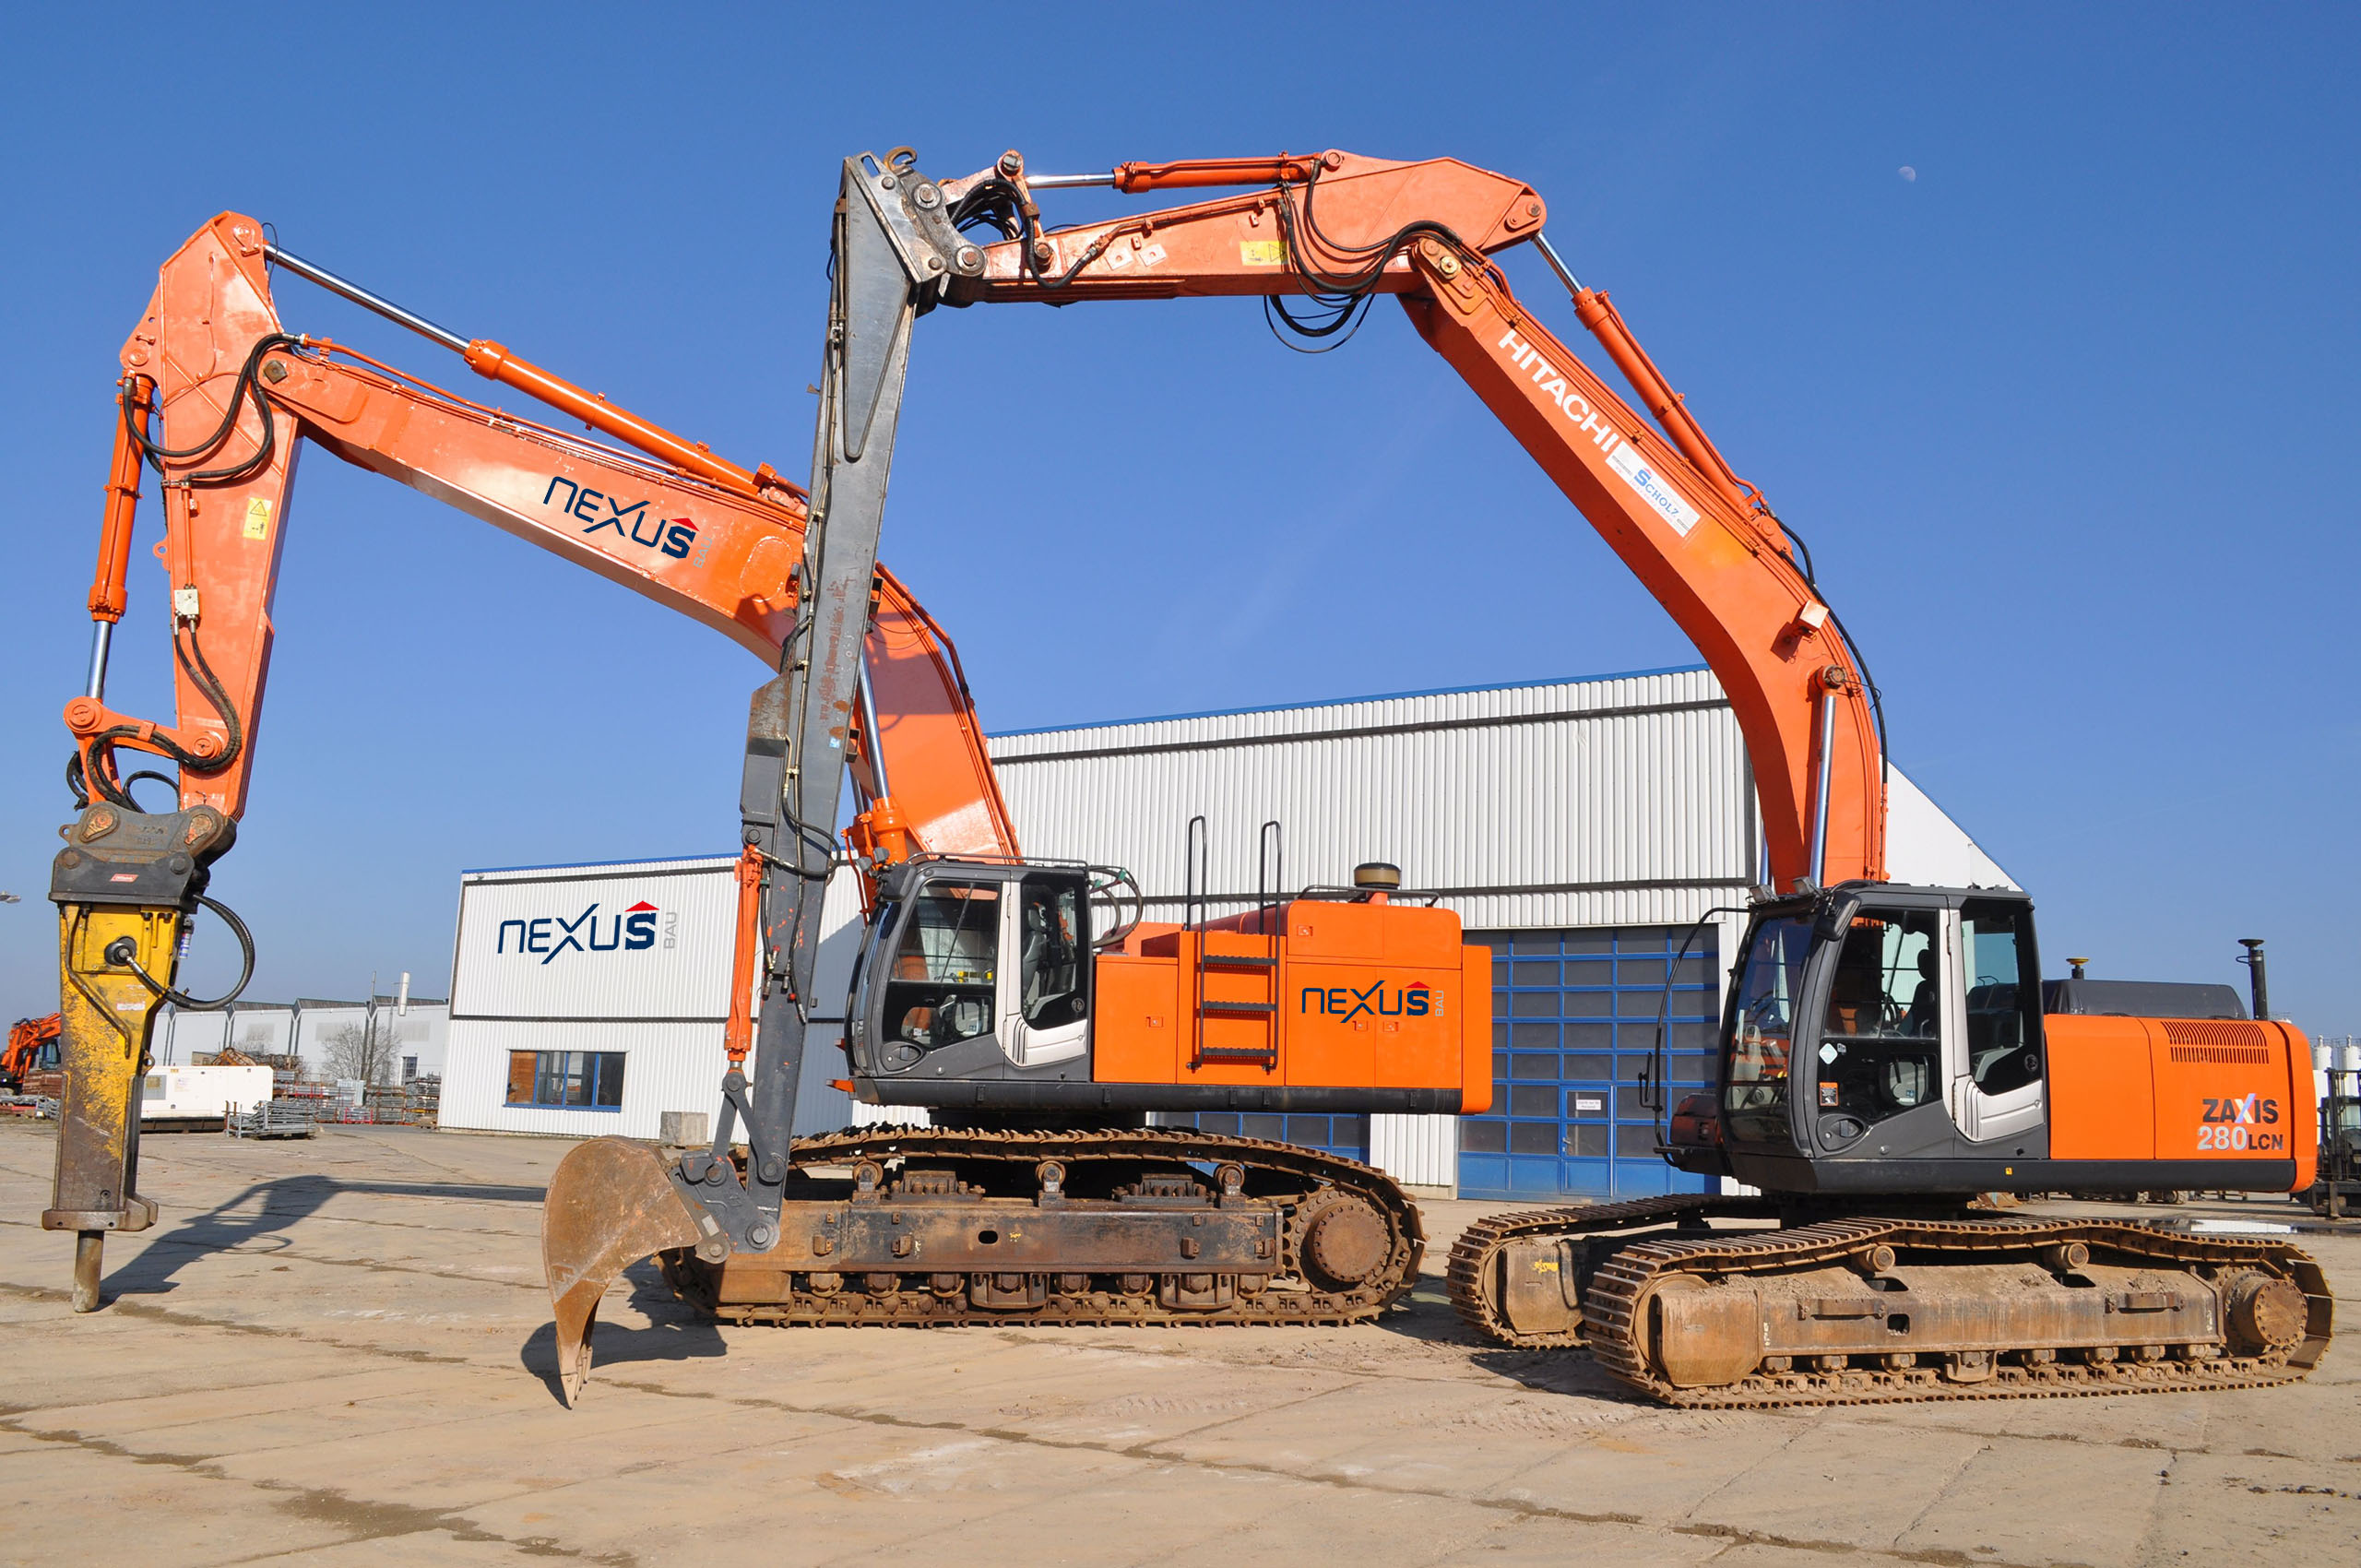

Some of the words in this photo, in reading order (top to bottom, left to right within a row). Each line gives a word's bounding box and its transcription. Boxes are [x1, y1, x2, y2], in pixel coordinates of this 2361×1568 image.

[1498, 329, 1619, 453] HITACHI
[542, 476, 698, 560] NEXUS
[693, 537, 713, 569] BAU
[497, 902, 658, 965] NEXUS
[663, 911, 678, 949] BAU
[1301, 980, 1430, 1024] NEXUS
[1434, 990, 1444, 1017] BAU
[2202, 1093, 2279, 1124] ZAXIS
